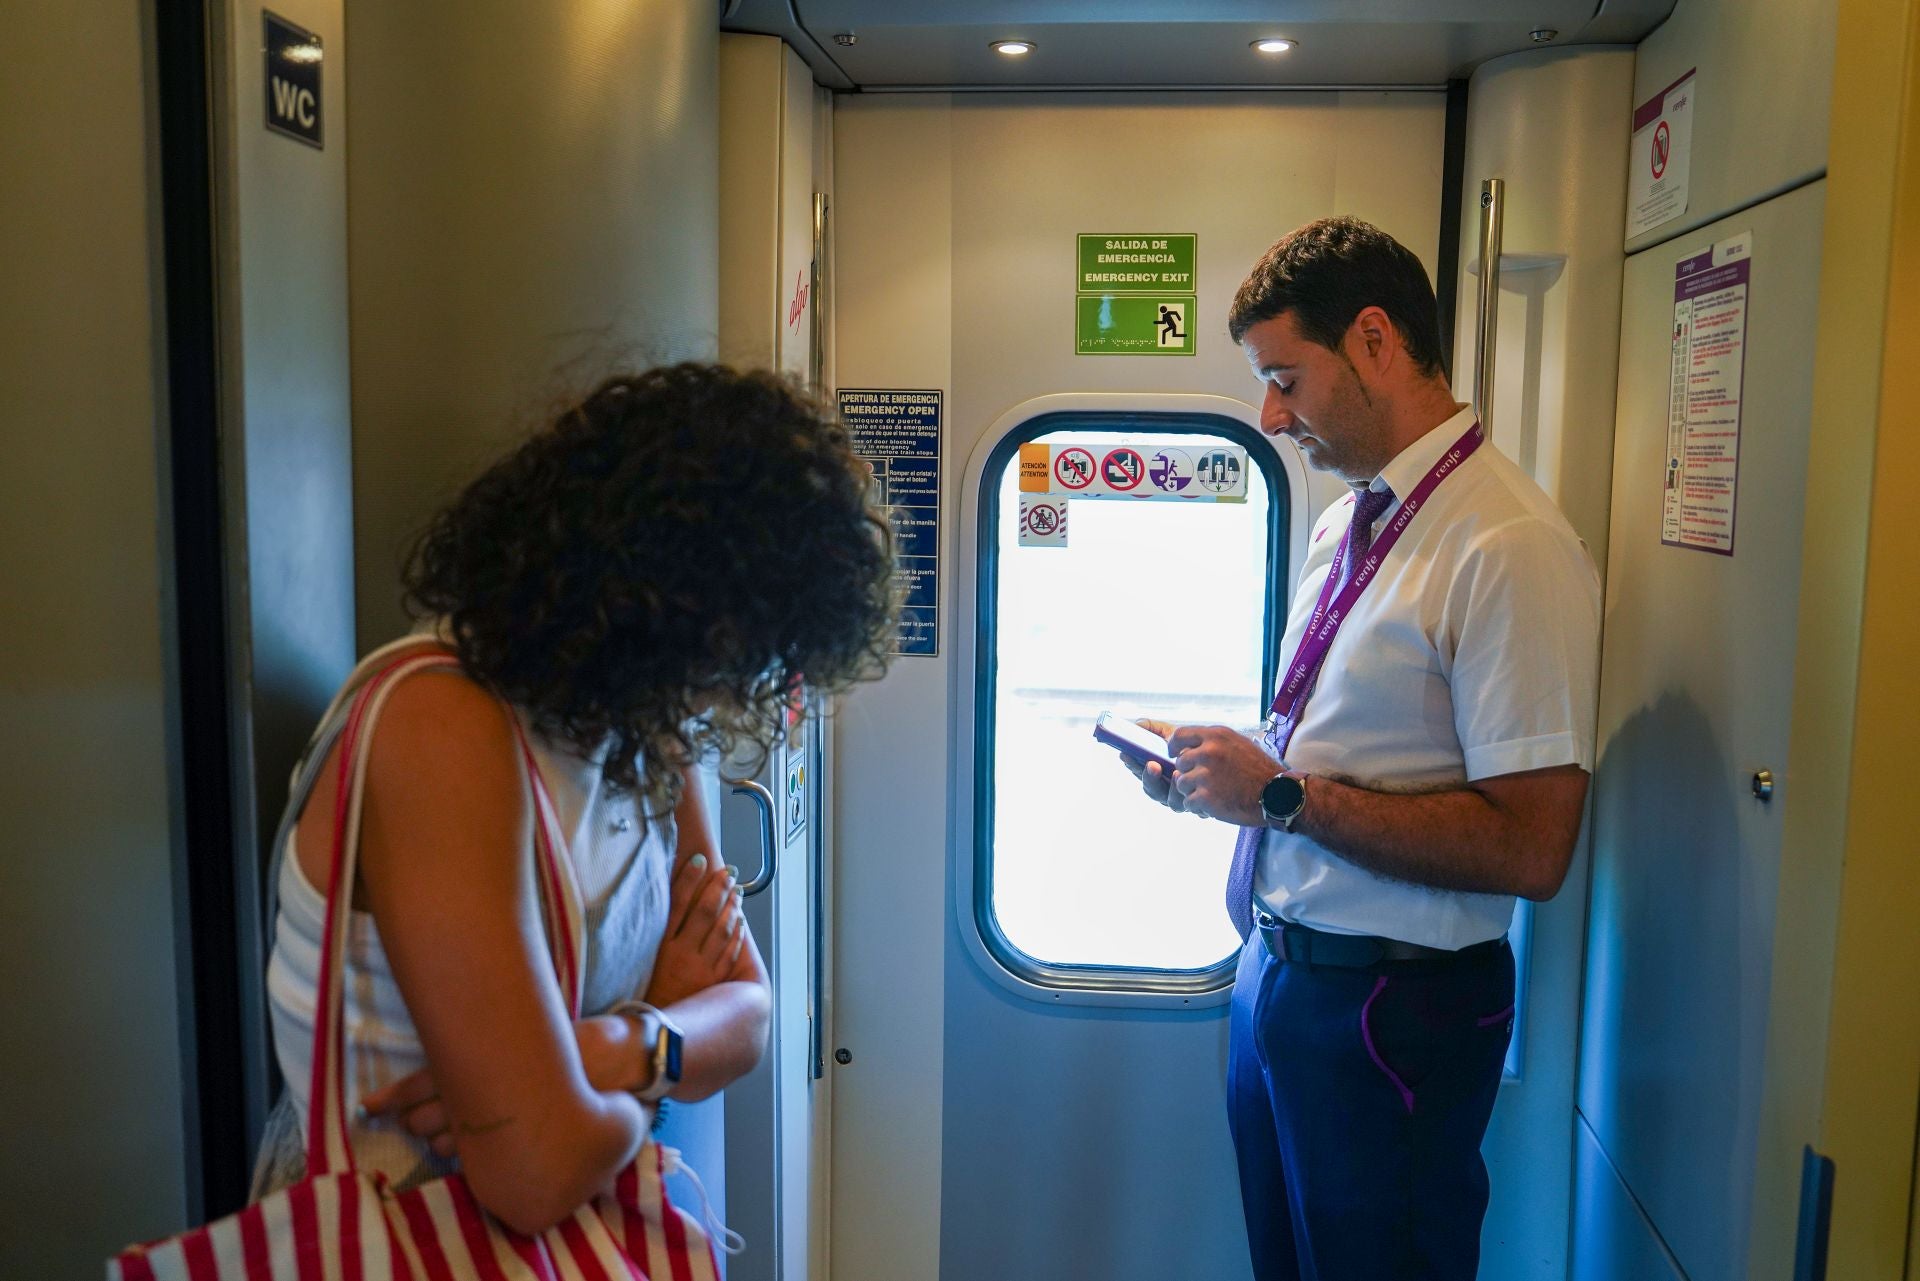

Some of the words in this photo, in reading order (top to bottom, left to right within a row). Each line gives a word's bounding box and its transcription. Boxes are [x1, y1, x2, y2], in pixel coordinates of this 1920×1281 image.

[272, 76, 315, 128] WC
[1105, 240, 1148, 250] SALIDA
[1151, 240, 1168, 250] DE
[1097, 254, 1175, 263] EMERGENCIA
[1085, 273, 1158, 282] EMERGENCY
[1162, 273, 1189, 282] EXIT
[840, 394, 878, 403] APERTURA
[880, 394, 890, 403] DE
[891, 394, 939, 404] EMERGENCIA
[844, 405, 906, 415] EMERGENCY
[908, 406, 935, 415] OPEN
[903, 424, 938, 432] emergencia
[889, 457, 894, 465] 1
[1435, 448, 1462, 479] renfe
[889, 469, 910, 477] Romper
[1393, 499, 1418, 533] renfe
[1329, 547, 1343, 579] renfe
[1355, 554, 1379, 587] renfe
[1318, 608, 1340, 641] renfe
[1287, 662, 1307, 694] renfe
